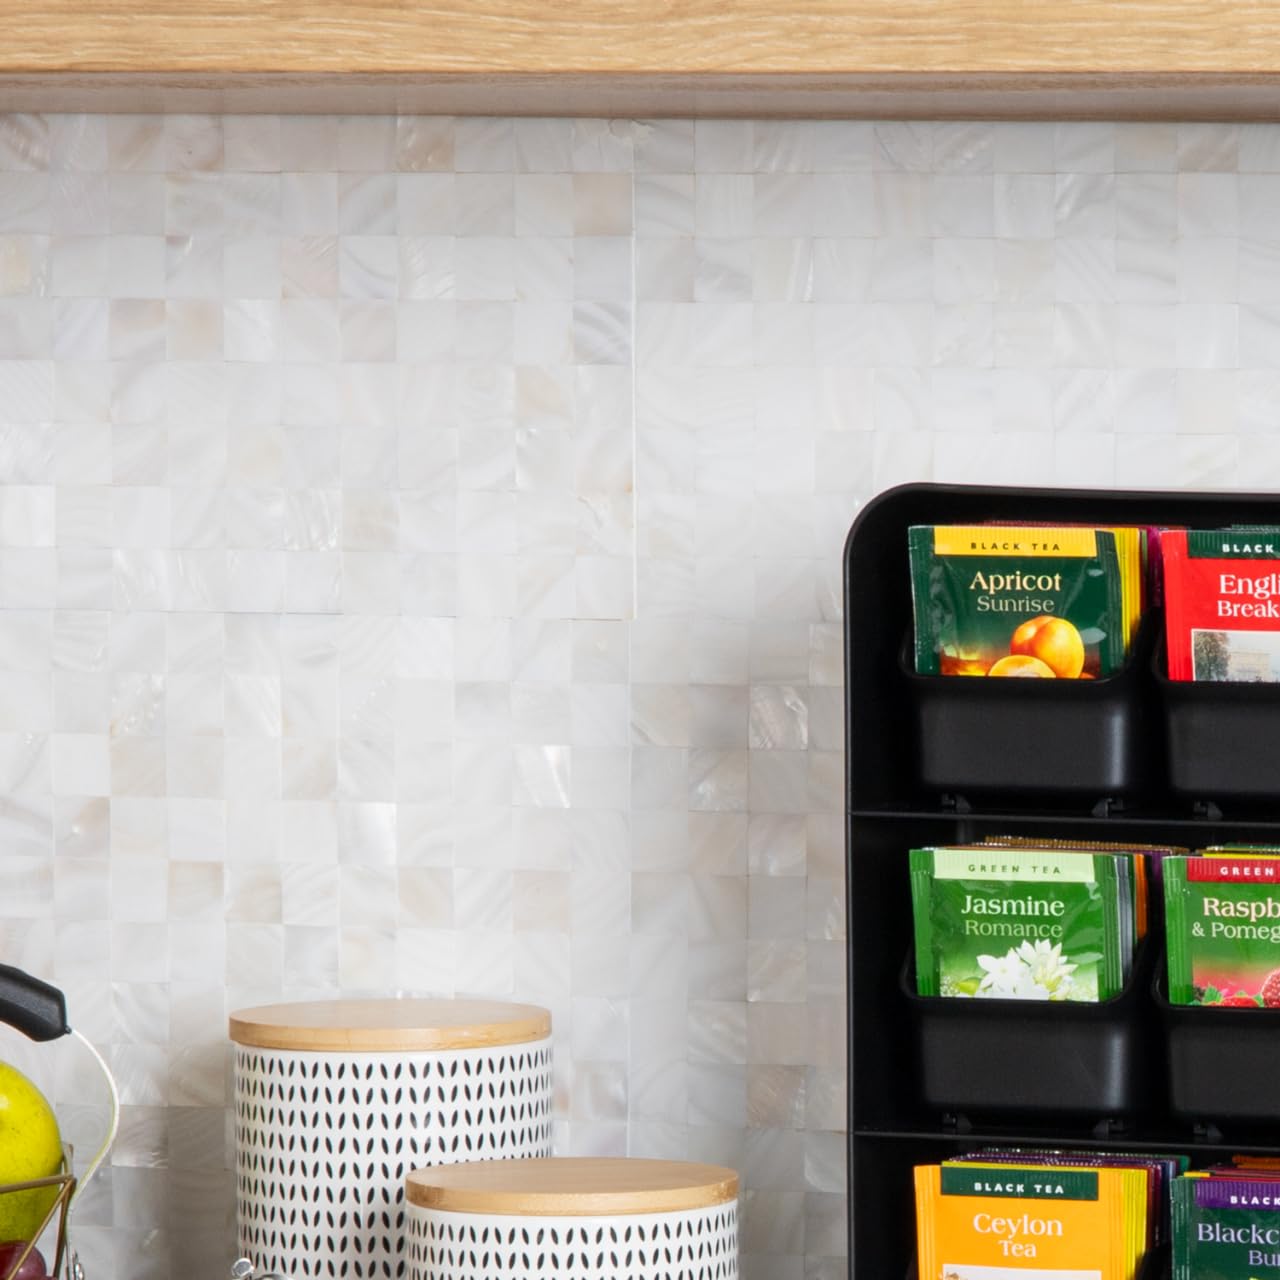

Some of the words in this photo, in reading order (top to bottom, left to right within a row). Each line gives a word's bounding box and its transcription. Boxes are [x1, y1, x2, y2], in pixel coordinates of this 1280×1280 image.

[970, 542, 1020, 550] BLACK
[1032, 543, 1060, 551] TEA
[1222, 543, 1274, 553] BLACK
[969, 570, 1062, 595] Apricot
[976, 595, 1055, 612] Sunrise
[968, 864, 1020, 873] GREEN
[1032, 865, 1061, 874] TEA
[1220, 866, 1275, 876] GREEN
[961, 895, 1065, 916] Jasmine
[965, 919, 1063, 938] Romance
[1191, 922, 1205, 937] &
[974, 1182, 1025, 1193] BLACK
[1034, 1184, 1065, 1194] TEA
[973, 1213, 1064, 1239] Ceylon
[998, 1239, 1037, 1258] Tea
